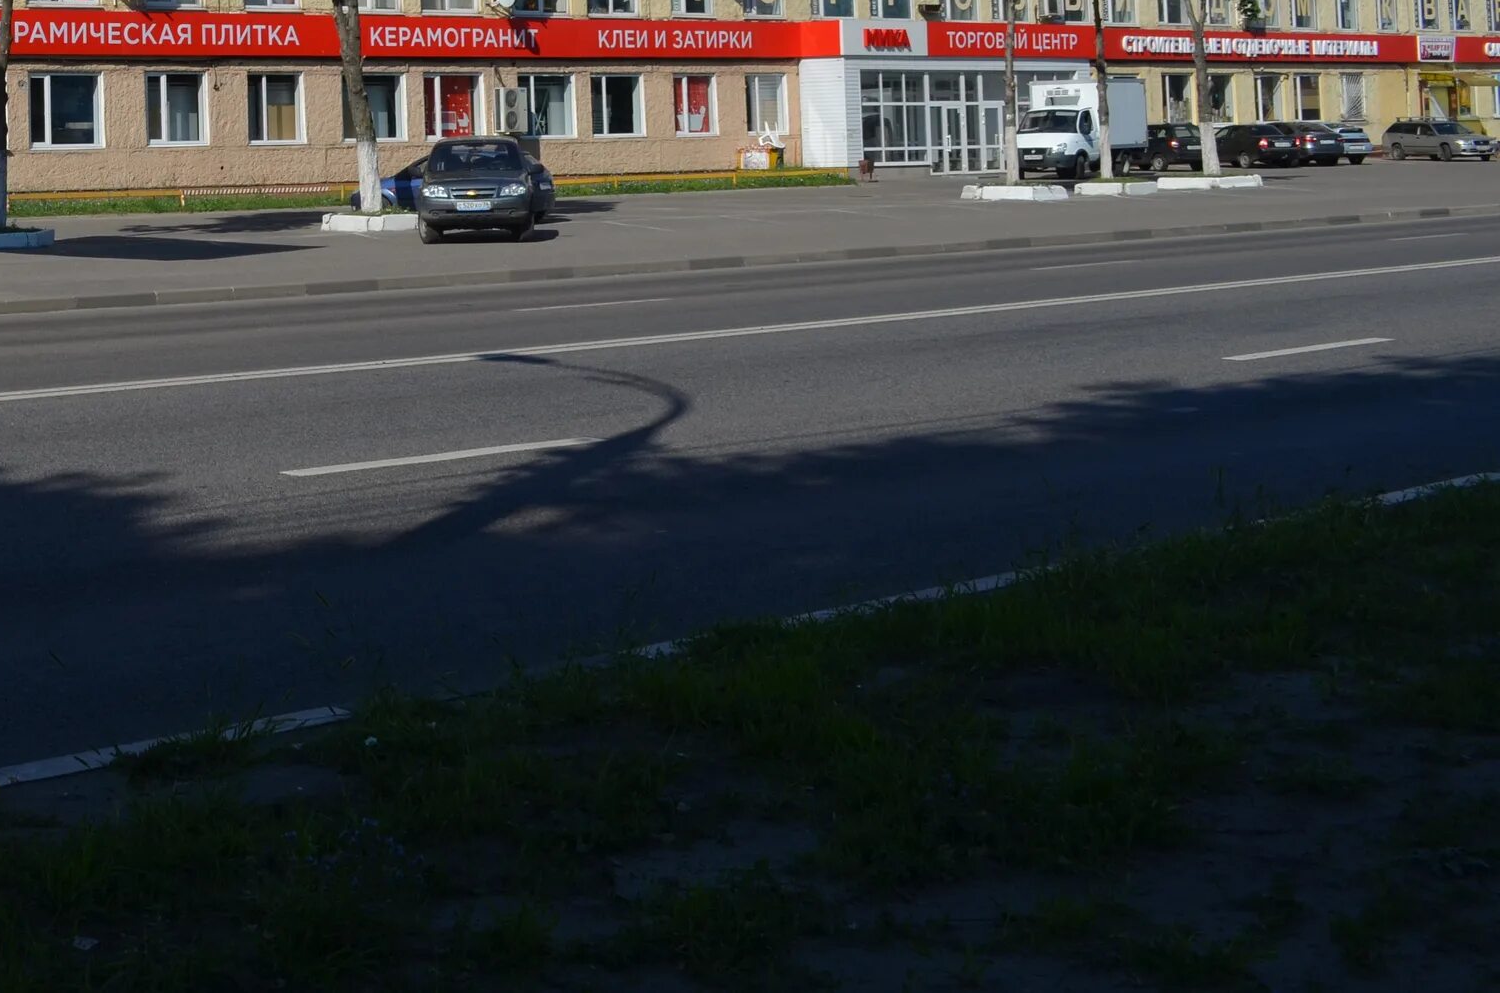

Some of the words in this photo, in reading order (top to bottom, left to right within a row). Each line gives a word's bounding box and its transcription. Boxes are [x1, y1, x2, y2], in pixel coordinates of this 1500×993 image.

[202, 24, 300, 46] ПЛИТКА
[369, 25, 539, 48] КЕРАМОГРАНИТ
[598, 29, 649, 49] КЛЕИ
[654, 30, 667, 49] И
[671, 30, 753, 50] ЗАТИРКИ
[864, 28, 912, 48] МИКА
[1032, 33, 1078, 53] ЦЕНТР
[1121, 35, 1222, 54] СТРОИТЕЛЬЫЕ
[1312, 39, 1378, 56] МАТЕРИАЛЫ
